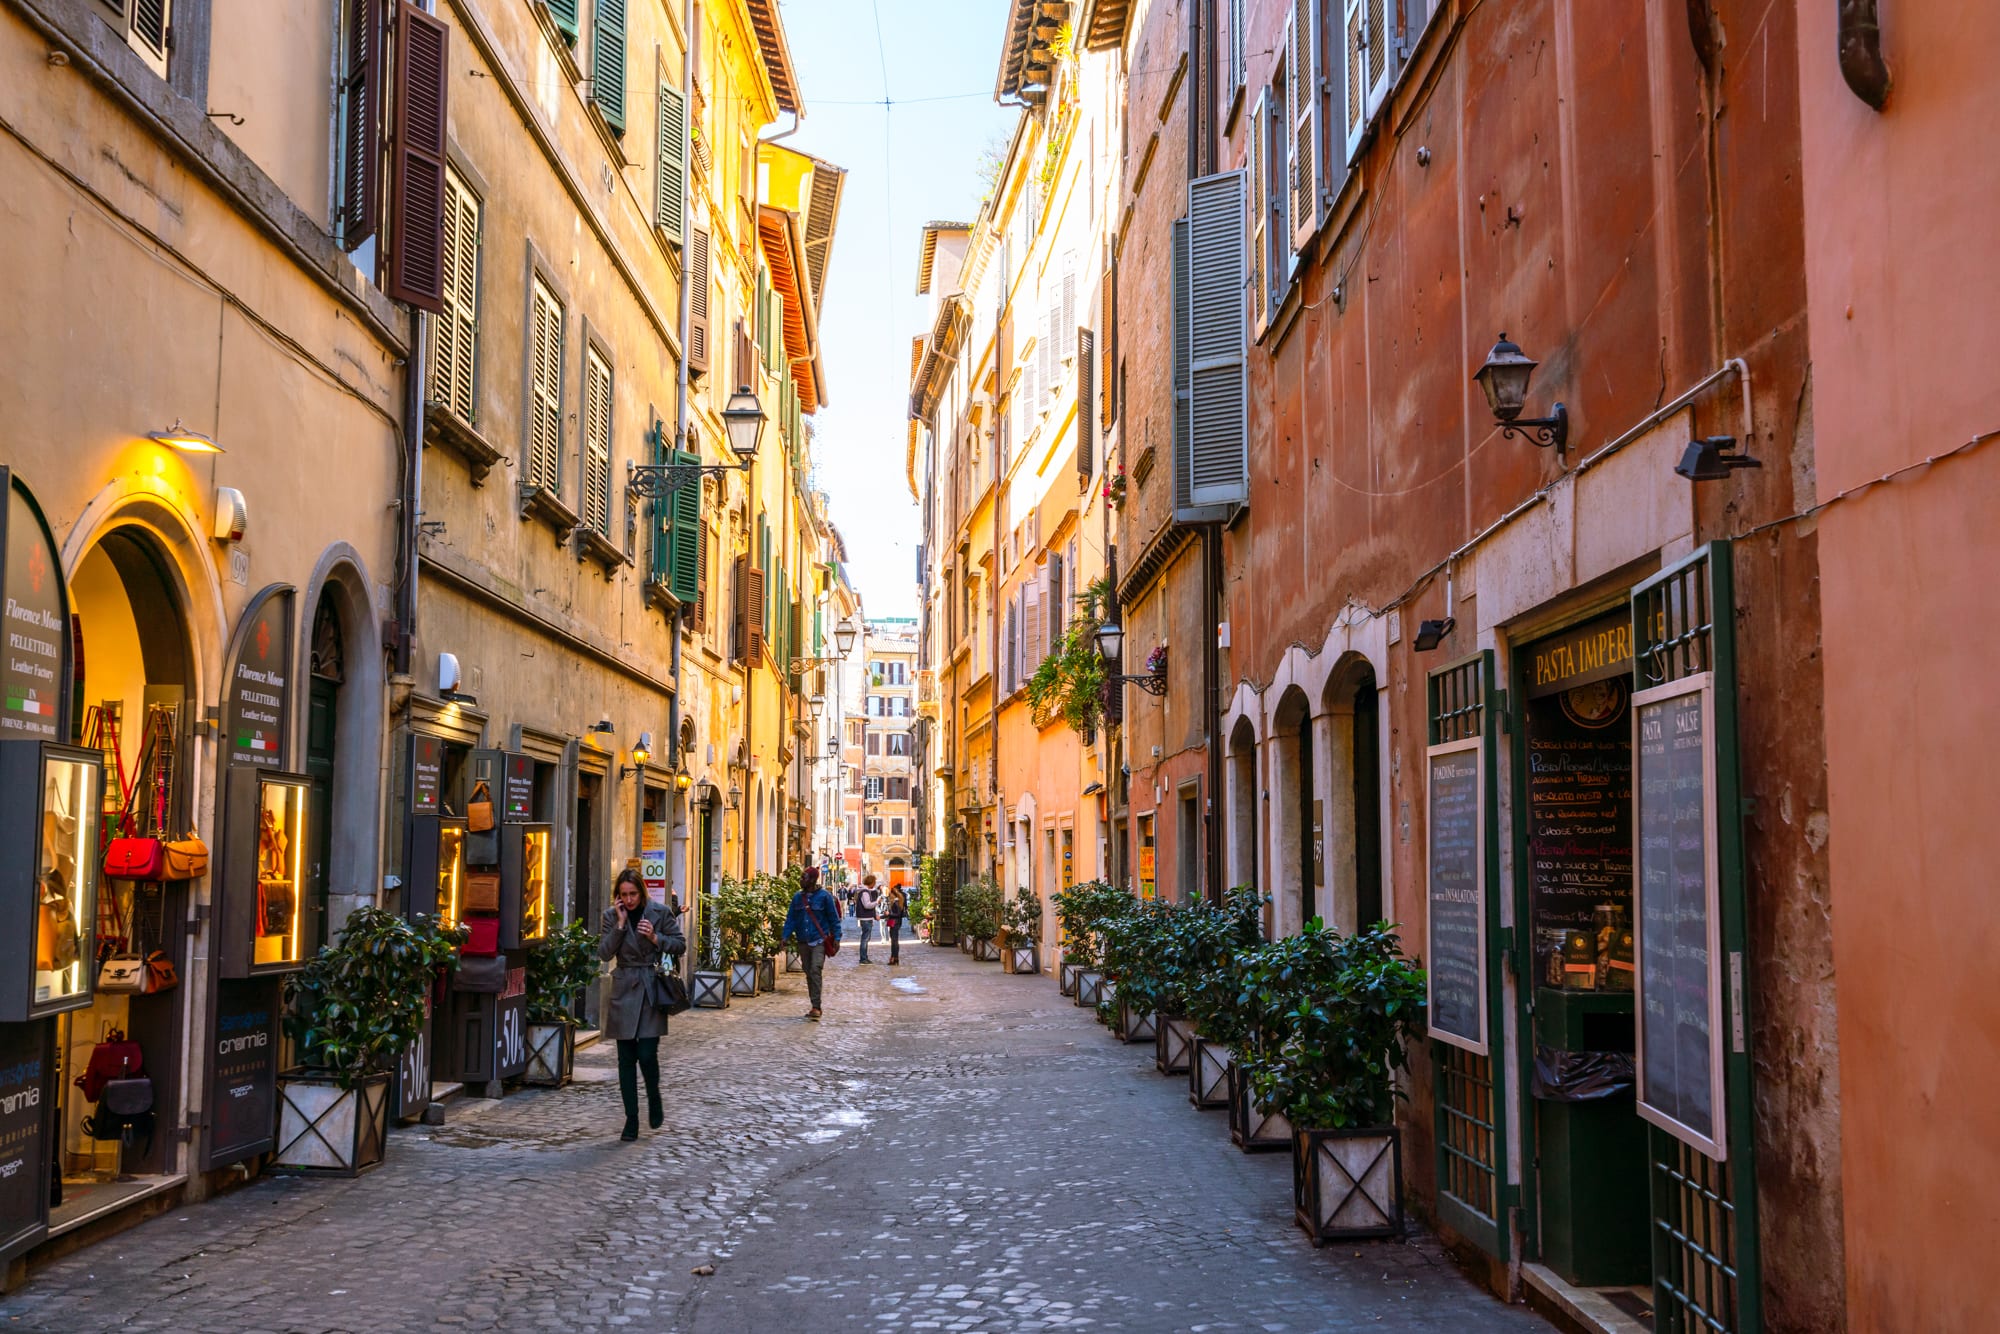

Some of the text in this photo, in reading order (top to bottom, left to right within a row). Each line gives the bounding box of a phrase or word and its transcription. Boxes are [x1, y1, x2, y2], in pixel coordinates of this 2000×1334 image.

[234, 554, 247, 583] 98
[6, 598, 62, 632] Florence Moon
[10, 632, 57, 658] PELLETTERIA
[11, 657, 54, 684] Leather Factory
[237, 663, 285, 688] Florence Moon
[1536, 645, 1577, 686] PASTA
[240, 688, 280, 708] PELLETTERIA
[241, 707, 278, 726] Leather Factory
[1676, 710, 1698, 735] SALSE
[1642, 720, 1662, 741] PASTA
[1433, 764, 1455, 780] PIADINE
[219, 1031, 268, 1055] cromia
